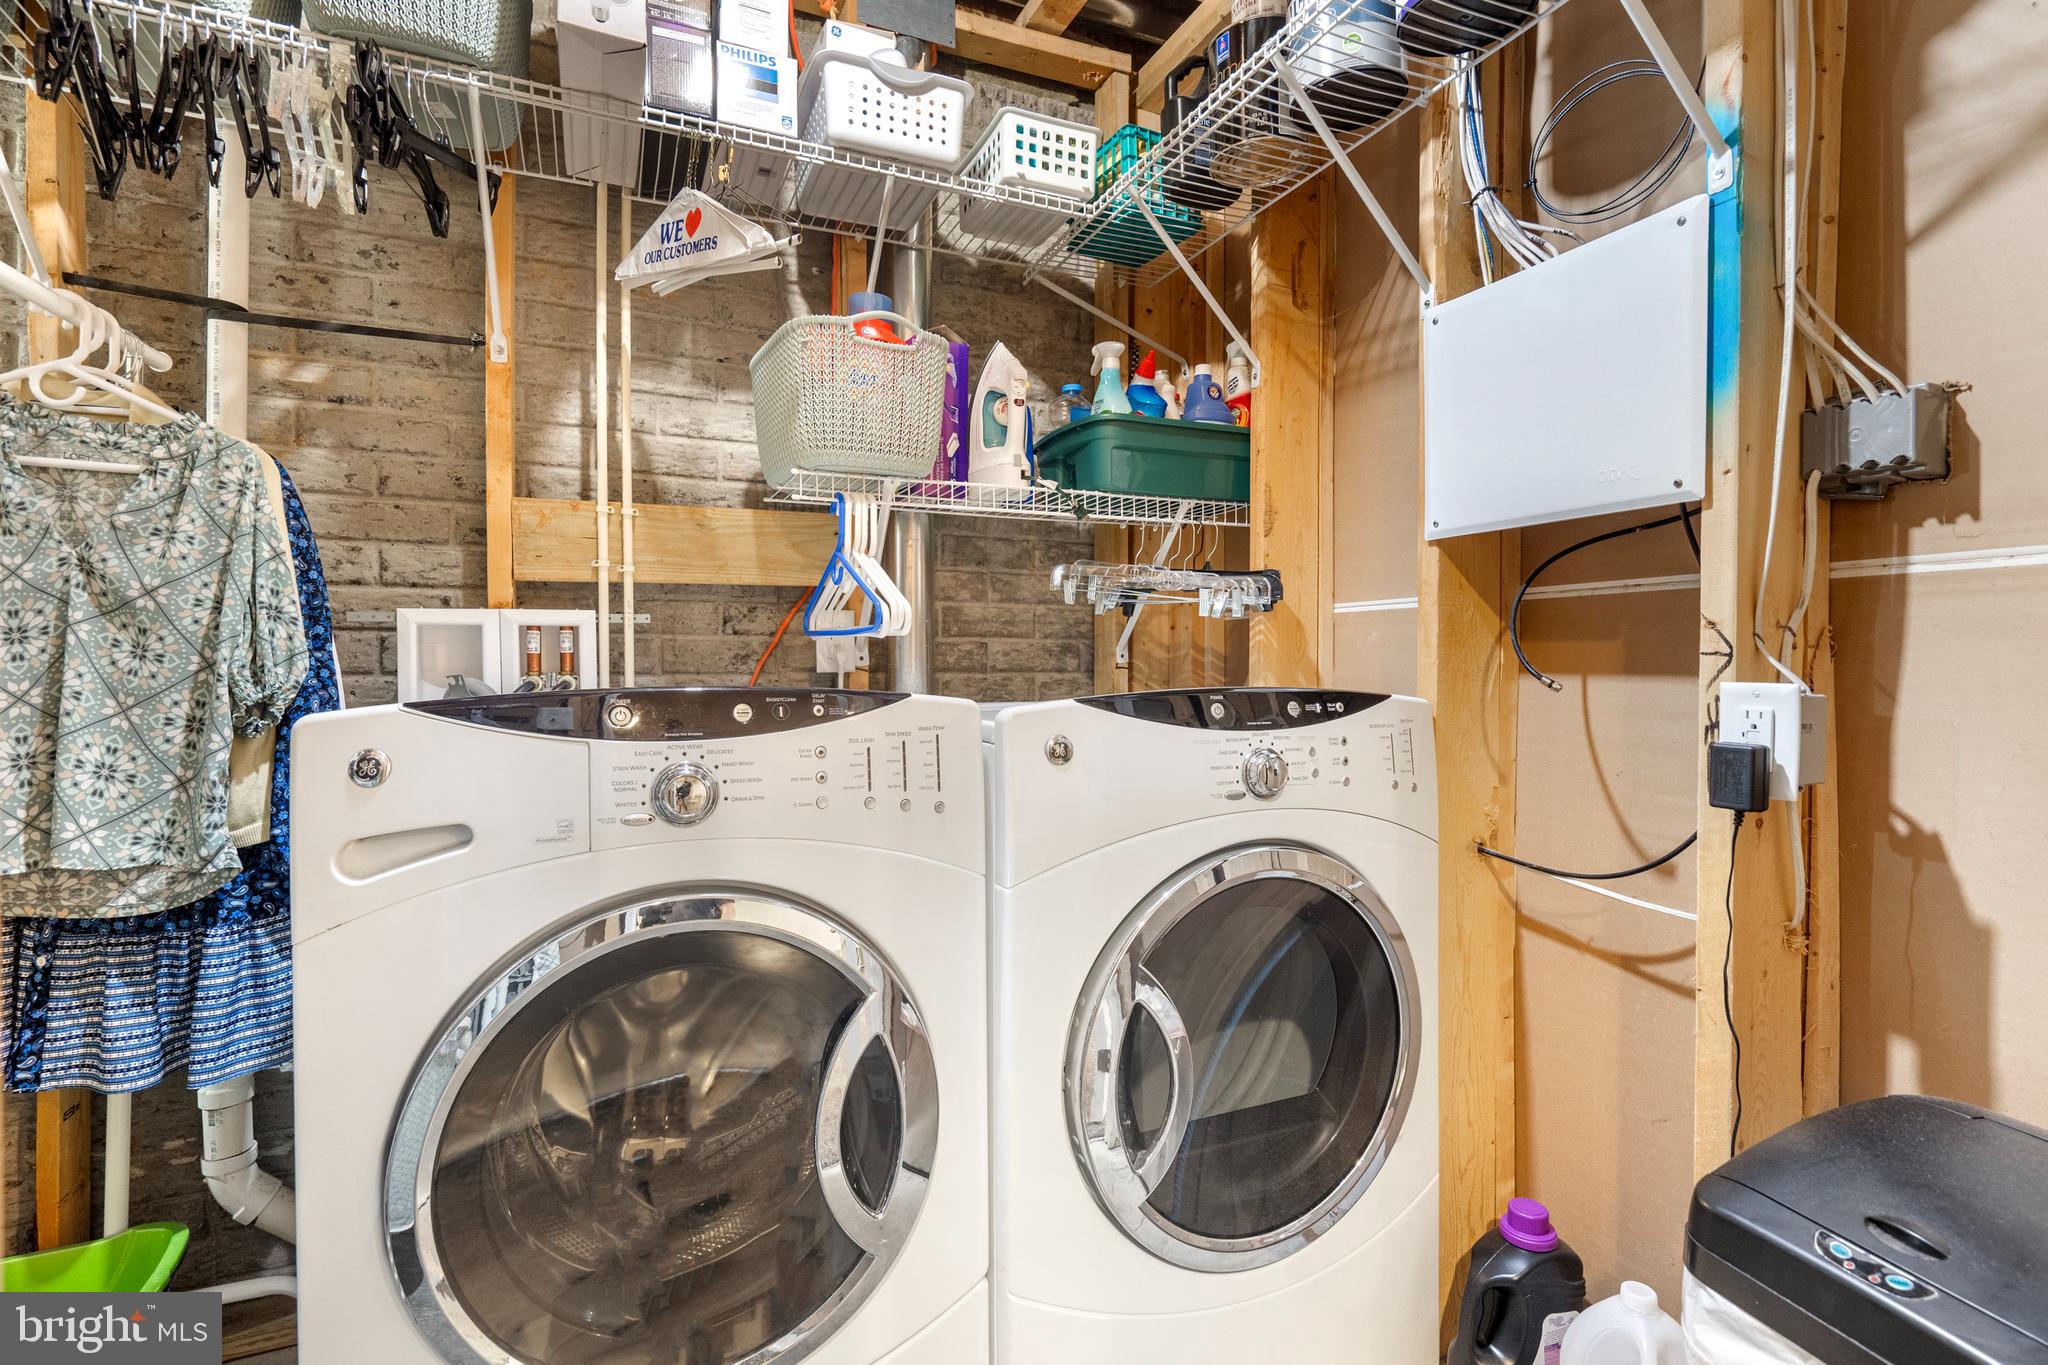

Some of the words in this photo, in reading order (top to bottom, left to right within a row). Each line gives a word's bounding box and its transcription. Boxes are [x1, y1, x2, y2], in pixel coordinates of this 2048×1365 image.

[720, 44, 777, 67] PHILIPS
[660, 219, 684, 245] WE
[644, 249, 662, 265] OUR
[663, 235, 718, 260] CUSTOMERS
